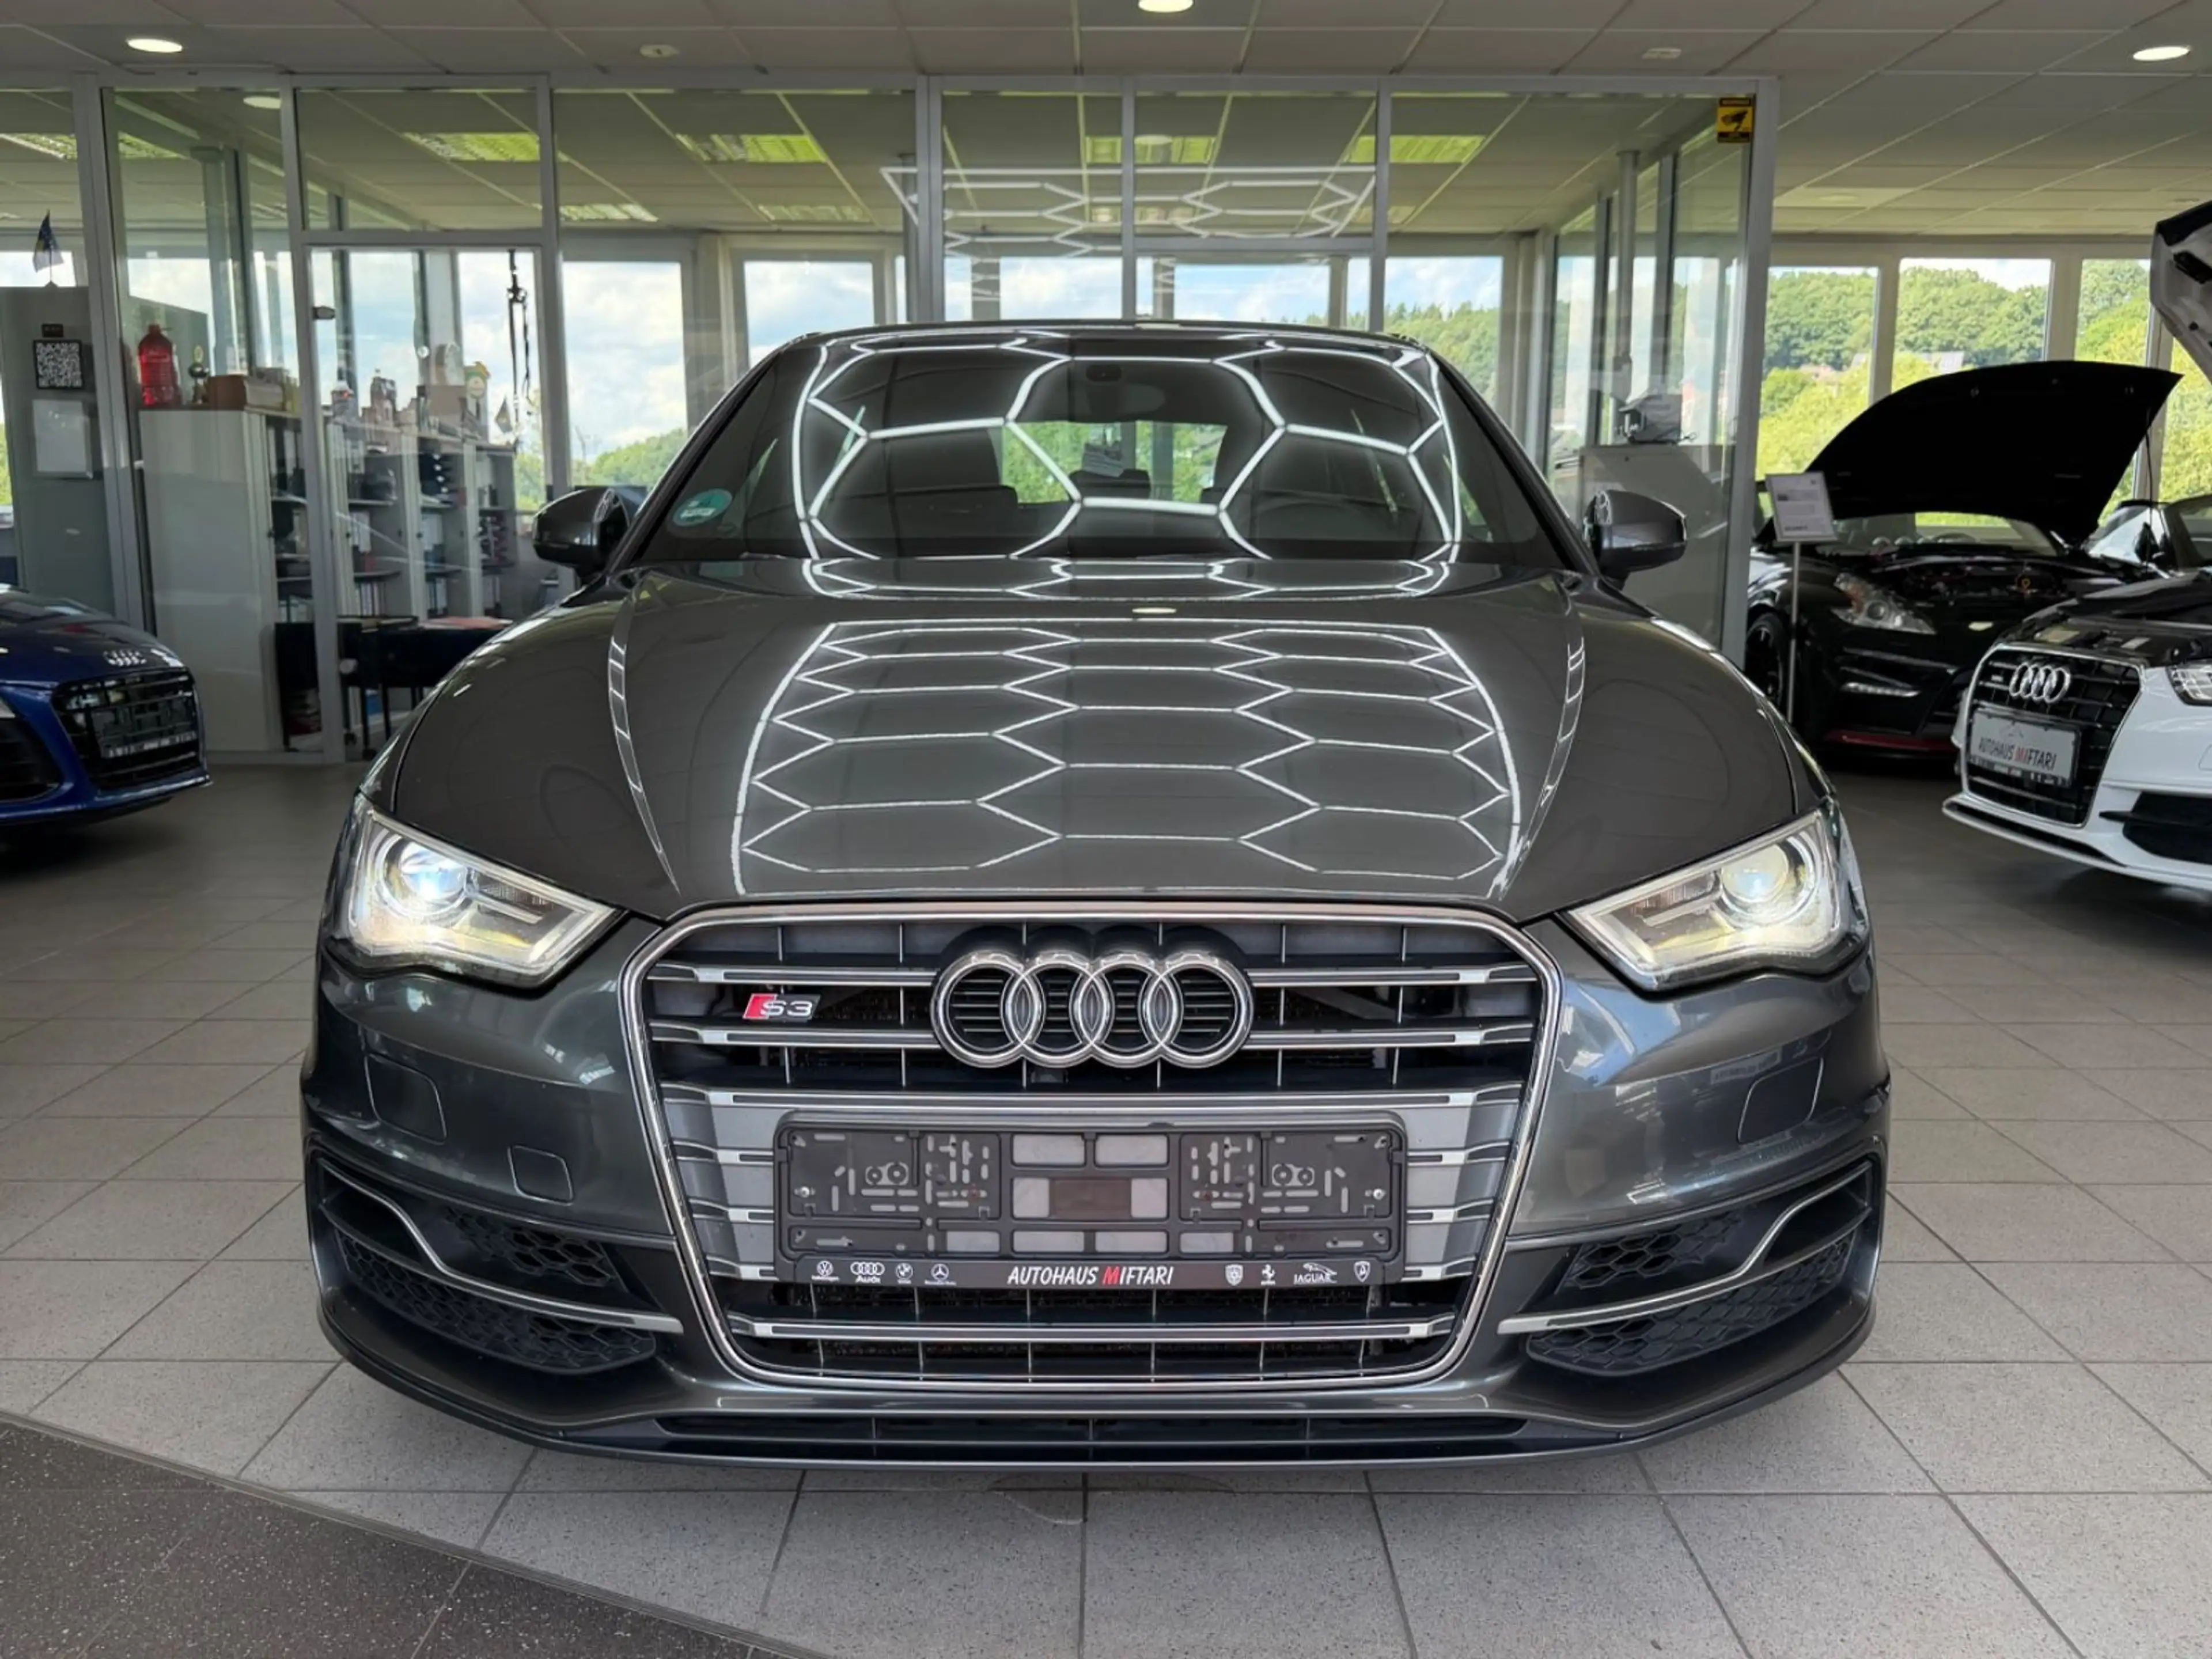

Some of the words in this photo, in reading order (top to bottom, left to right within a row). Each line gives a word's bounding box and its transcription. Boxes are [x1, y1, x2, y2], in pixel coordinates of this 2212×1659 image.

[2016, 746, 2058, 771] MIFTARI
[760, 999, 813, 1017] S3
[1007, 1266, 1099, 1285] AUTOHAUS
[1102, 1266, 1174, 1285] MIFTARI
[1294, 1273, 1338, 1285] JAGUAR
